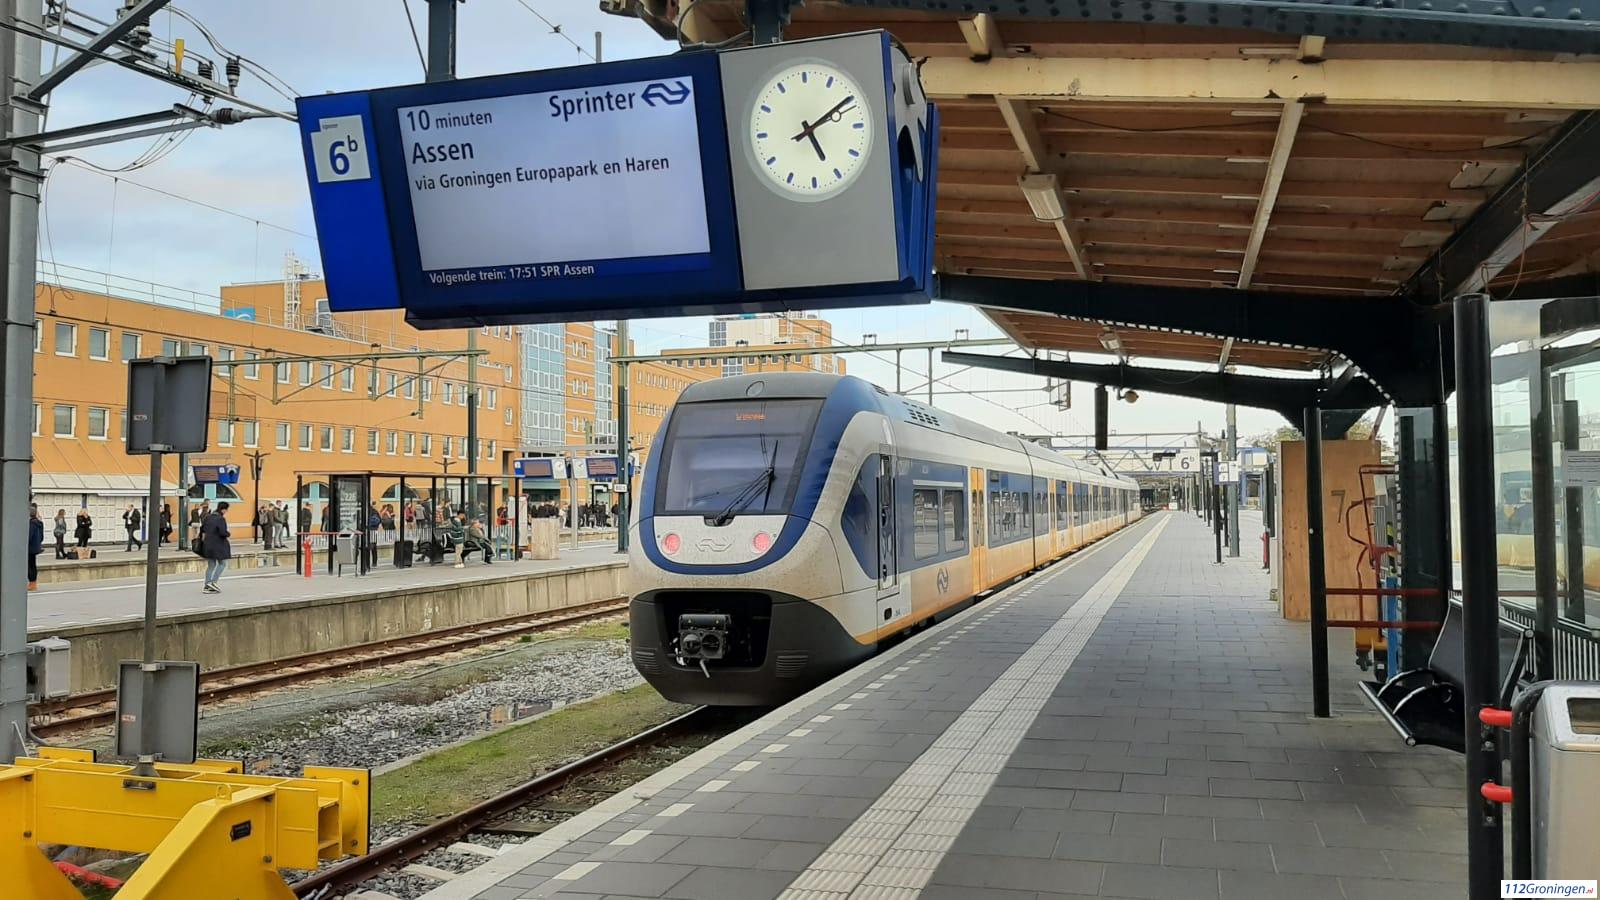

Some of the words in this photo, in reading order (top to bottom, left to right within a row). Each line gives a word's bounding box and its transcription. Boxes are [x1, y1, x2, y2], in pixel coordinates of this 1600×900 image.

[549, 91, 636, 122] Sprinter
[406, 109, 431, 132] 10
[435, 112, 493, 129] minuten
[412, 141, 474, 164] Assen
[415, 175, 436, 191] via
[439, 170, 512, 188] Groningen
[515, 160, 599, 183] Europapark
[603, 161, 621, 174] en
[625, 156, 670, 172] Haren
[429, 270, 477, 286] Volgende
[479, 268, 507, 281] trein:
[509, 267, 537, 279] 17:51
[540, 265, 561, 277] SPR
[563, 264, 595, 276] Assen
